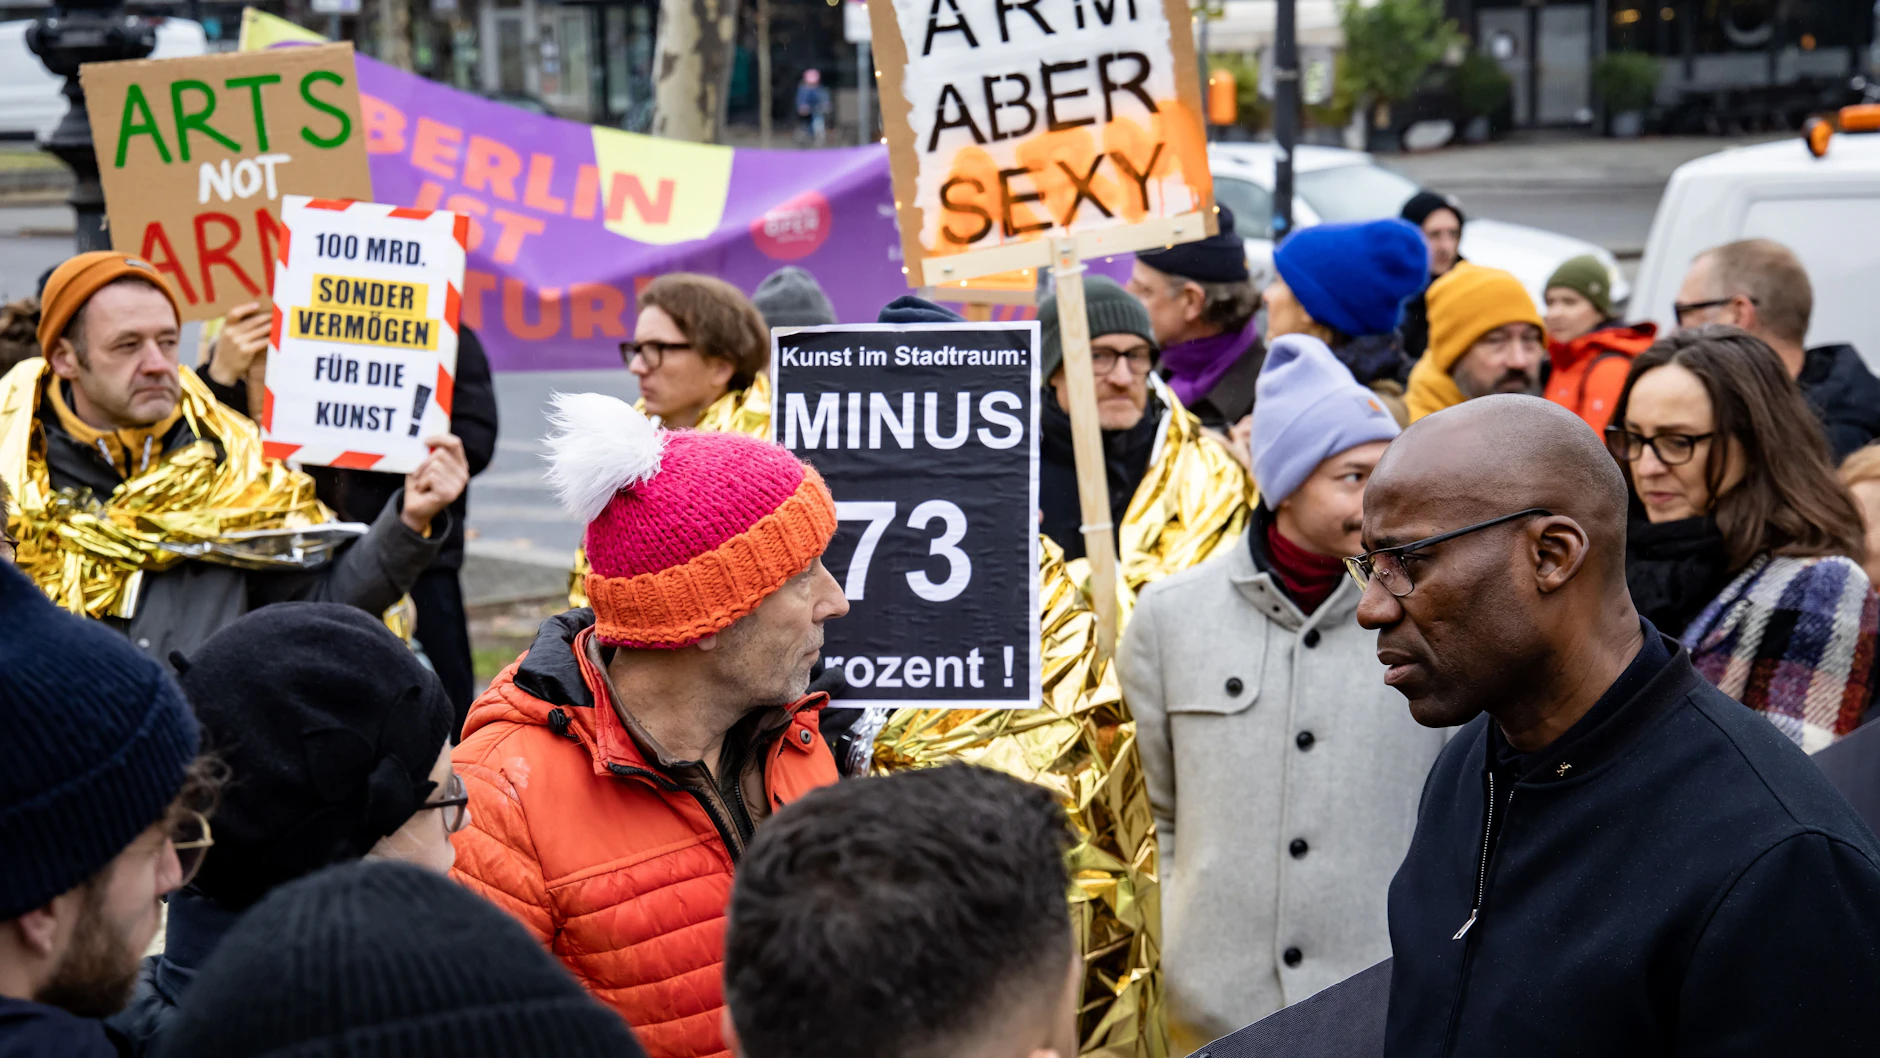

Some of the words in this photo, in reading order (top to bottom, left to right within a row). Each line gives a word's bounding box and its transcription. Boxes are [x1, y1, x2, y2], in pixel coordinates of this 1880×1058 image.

[115, 71, 351, 168] ARTS
[928, 52, 1159, 152] ABER
[199, 154, 291, 203] NOT
[359, 93, 675, 225] BERLIN
[939, 142, 1165, 244] SEXY
[315, 232, 358, 260] 100
[366, 237, 427, 267] MRD.
[319, 277, 415, 310] SONDER
[298, 310, 430, 346] VERMÖGEN
[315, 352, 360, 384] FÜR
[367, 362, 405, 388] DIE
[782, 346, 853, 367] Kunst
[859, 346, 887, 367] im
[894, 344, 1028, 366] Stadtraum:
[315, 401, 397, 432] KUNST
[785, 391, 1024, 450] MINUS
[834, 499, 972, 601] 73
[824, 647, 985, 688] rozent
[1003, 645, 1014, 688] !
